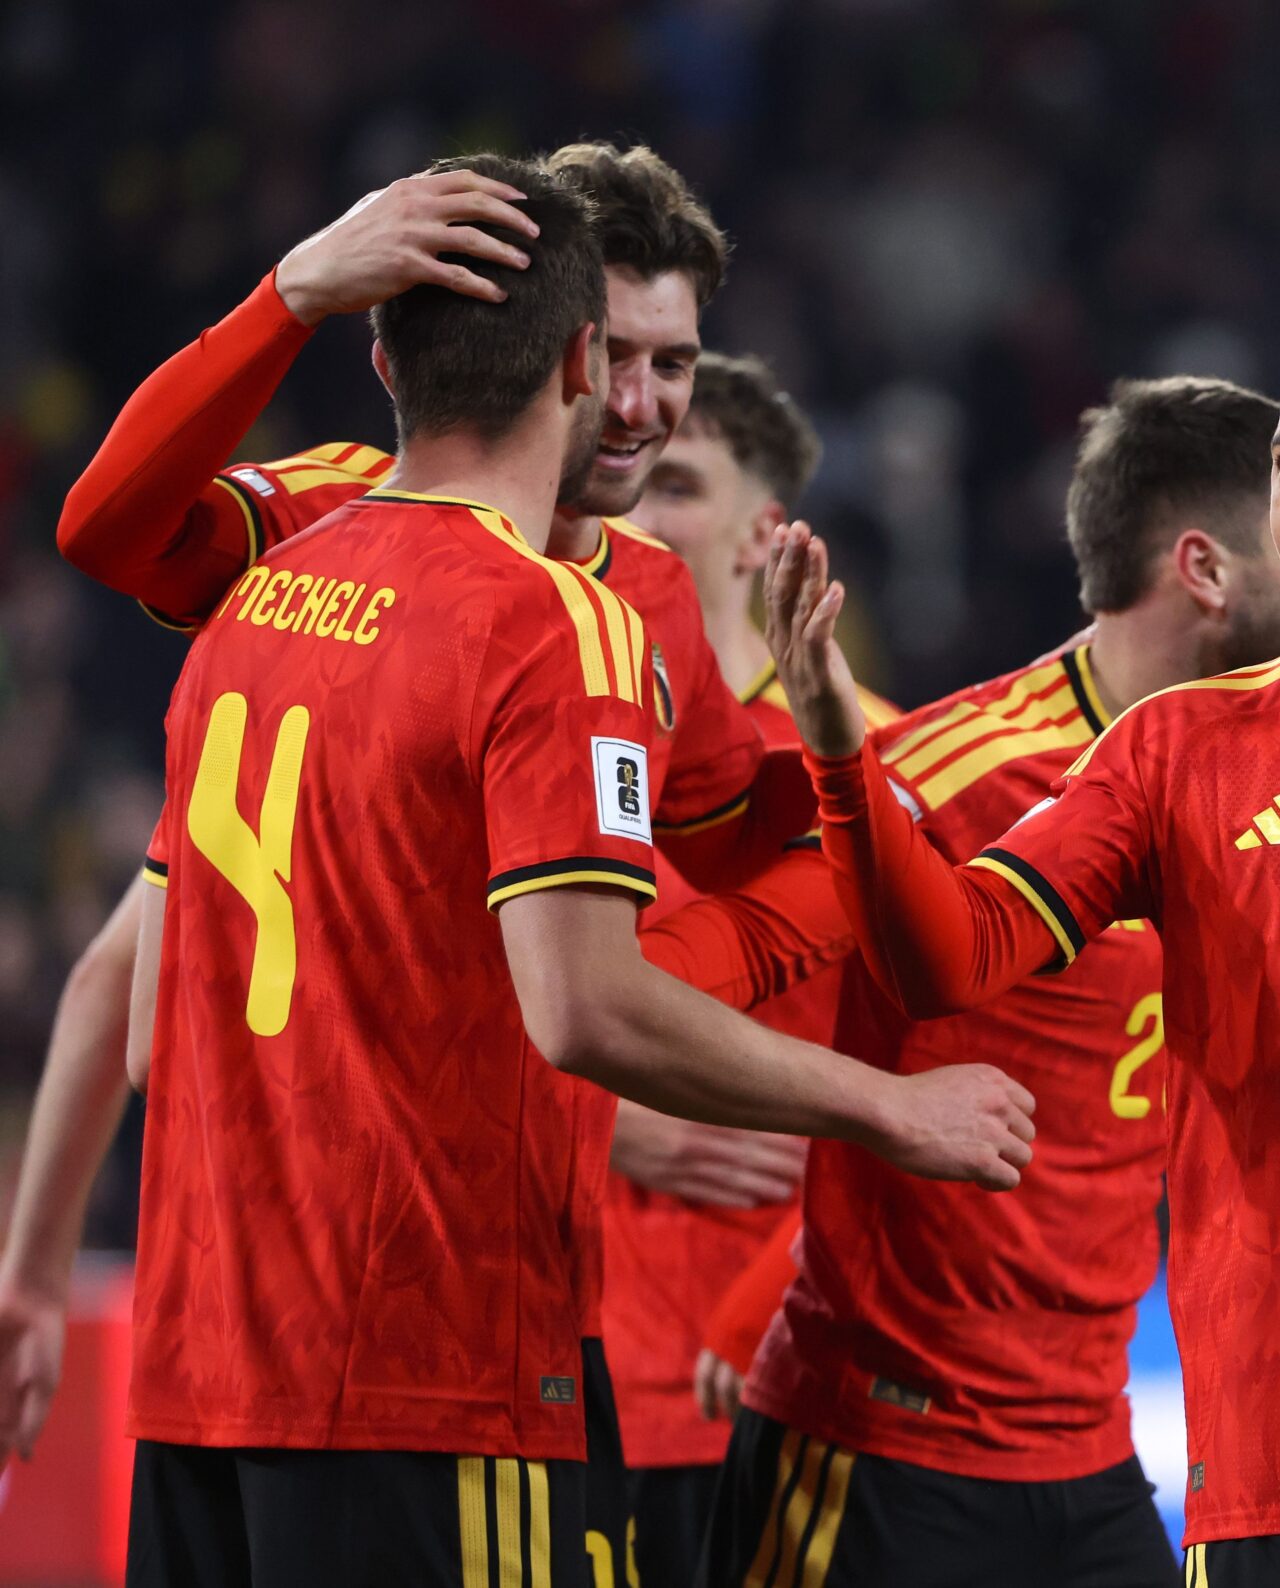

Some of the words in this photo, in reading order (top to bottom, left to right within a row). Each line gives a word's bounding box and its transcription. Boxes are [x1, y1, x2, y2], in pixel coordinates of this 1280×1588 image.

[217, 566, 396, 645] MECHELE
[188, 692, 310, 1036] 4
[1110, 992, 1168, 1119] 2
